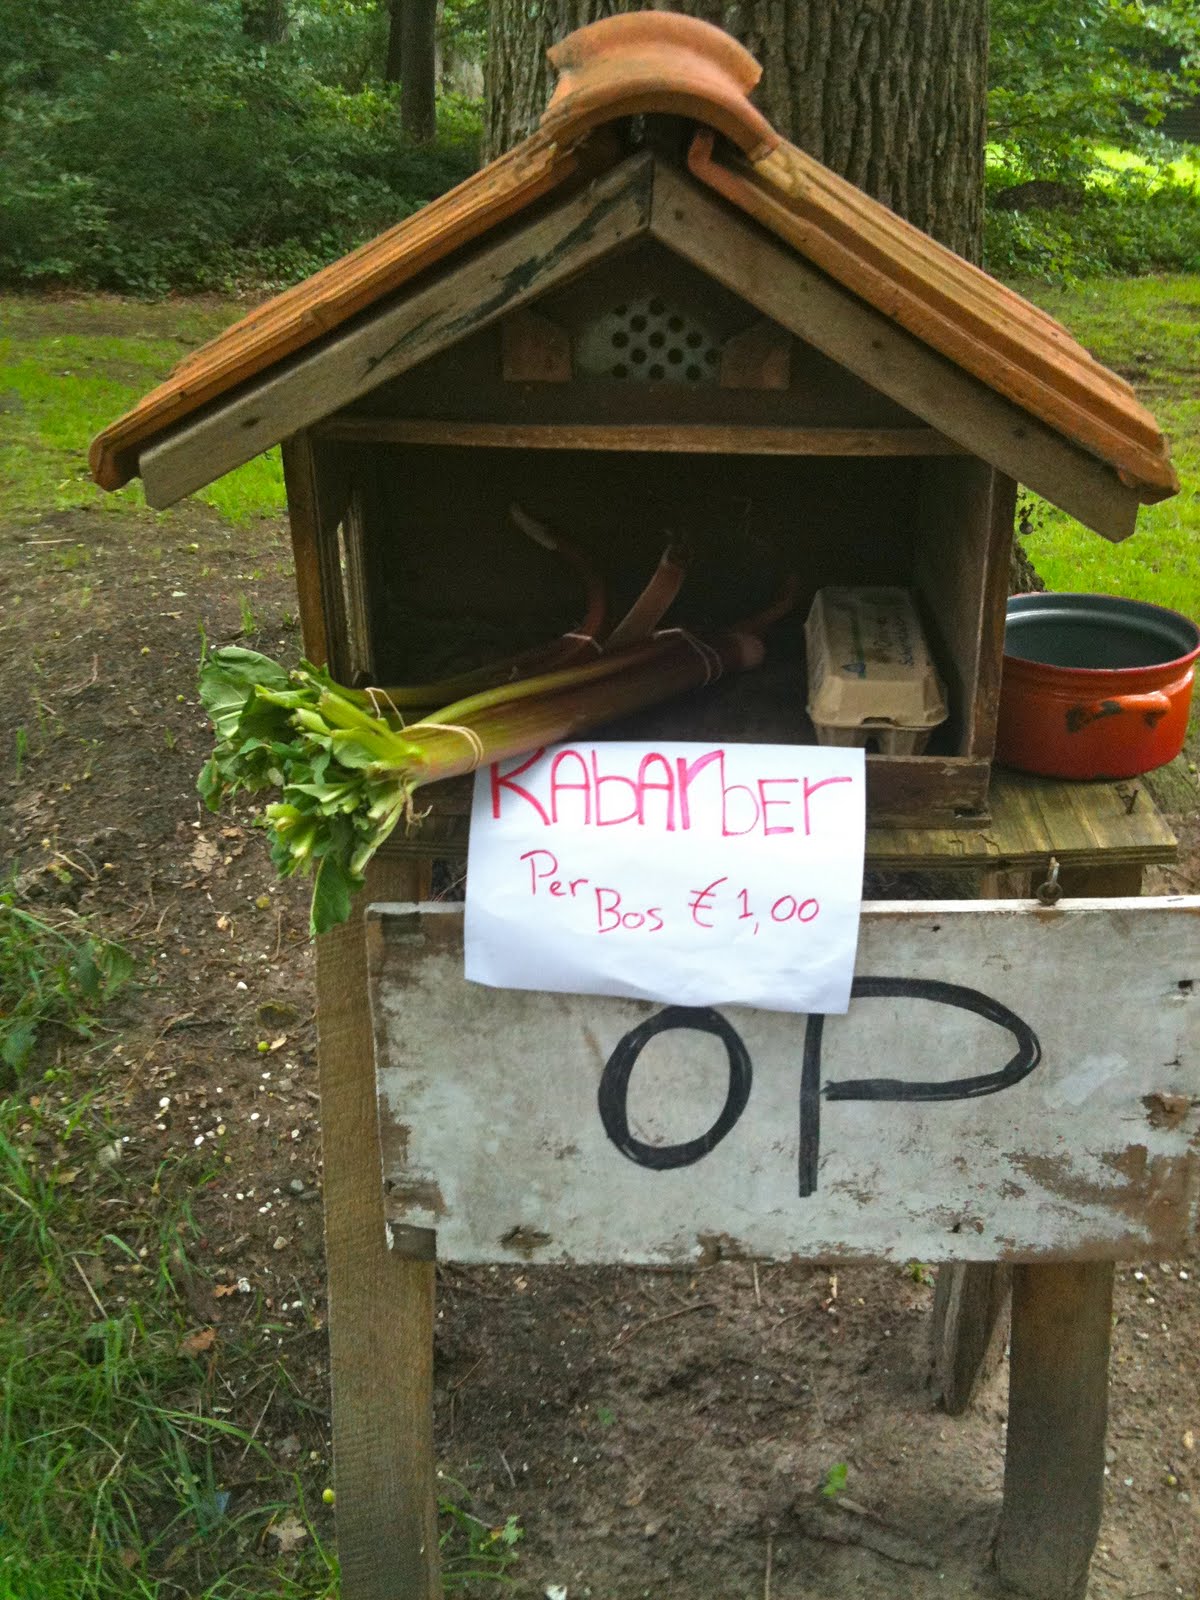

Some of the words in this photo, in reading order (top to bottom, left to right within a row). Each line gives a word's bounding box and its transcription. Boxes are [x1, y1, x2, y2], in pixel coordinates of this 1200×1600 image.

[519, 848, 589, 897] Per
[596, 886, 665, 934] Bos
[597, 975, 1042, 1199] OP
